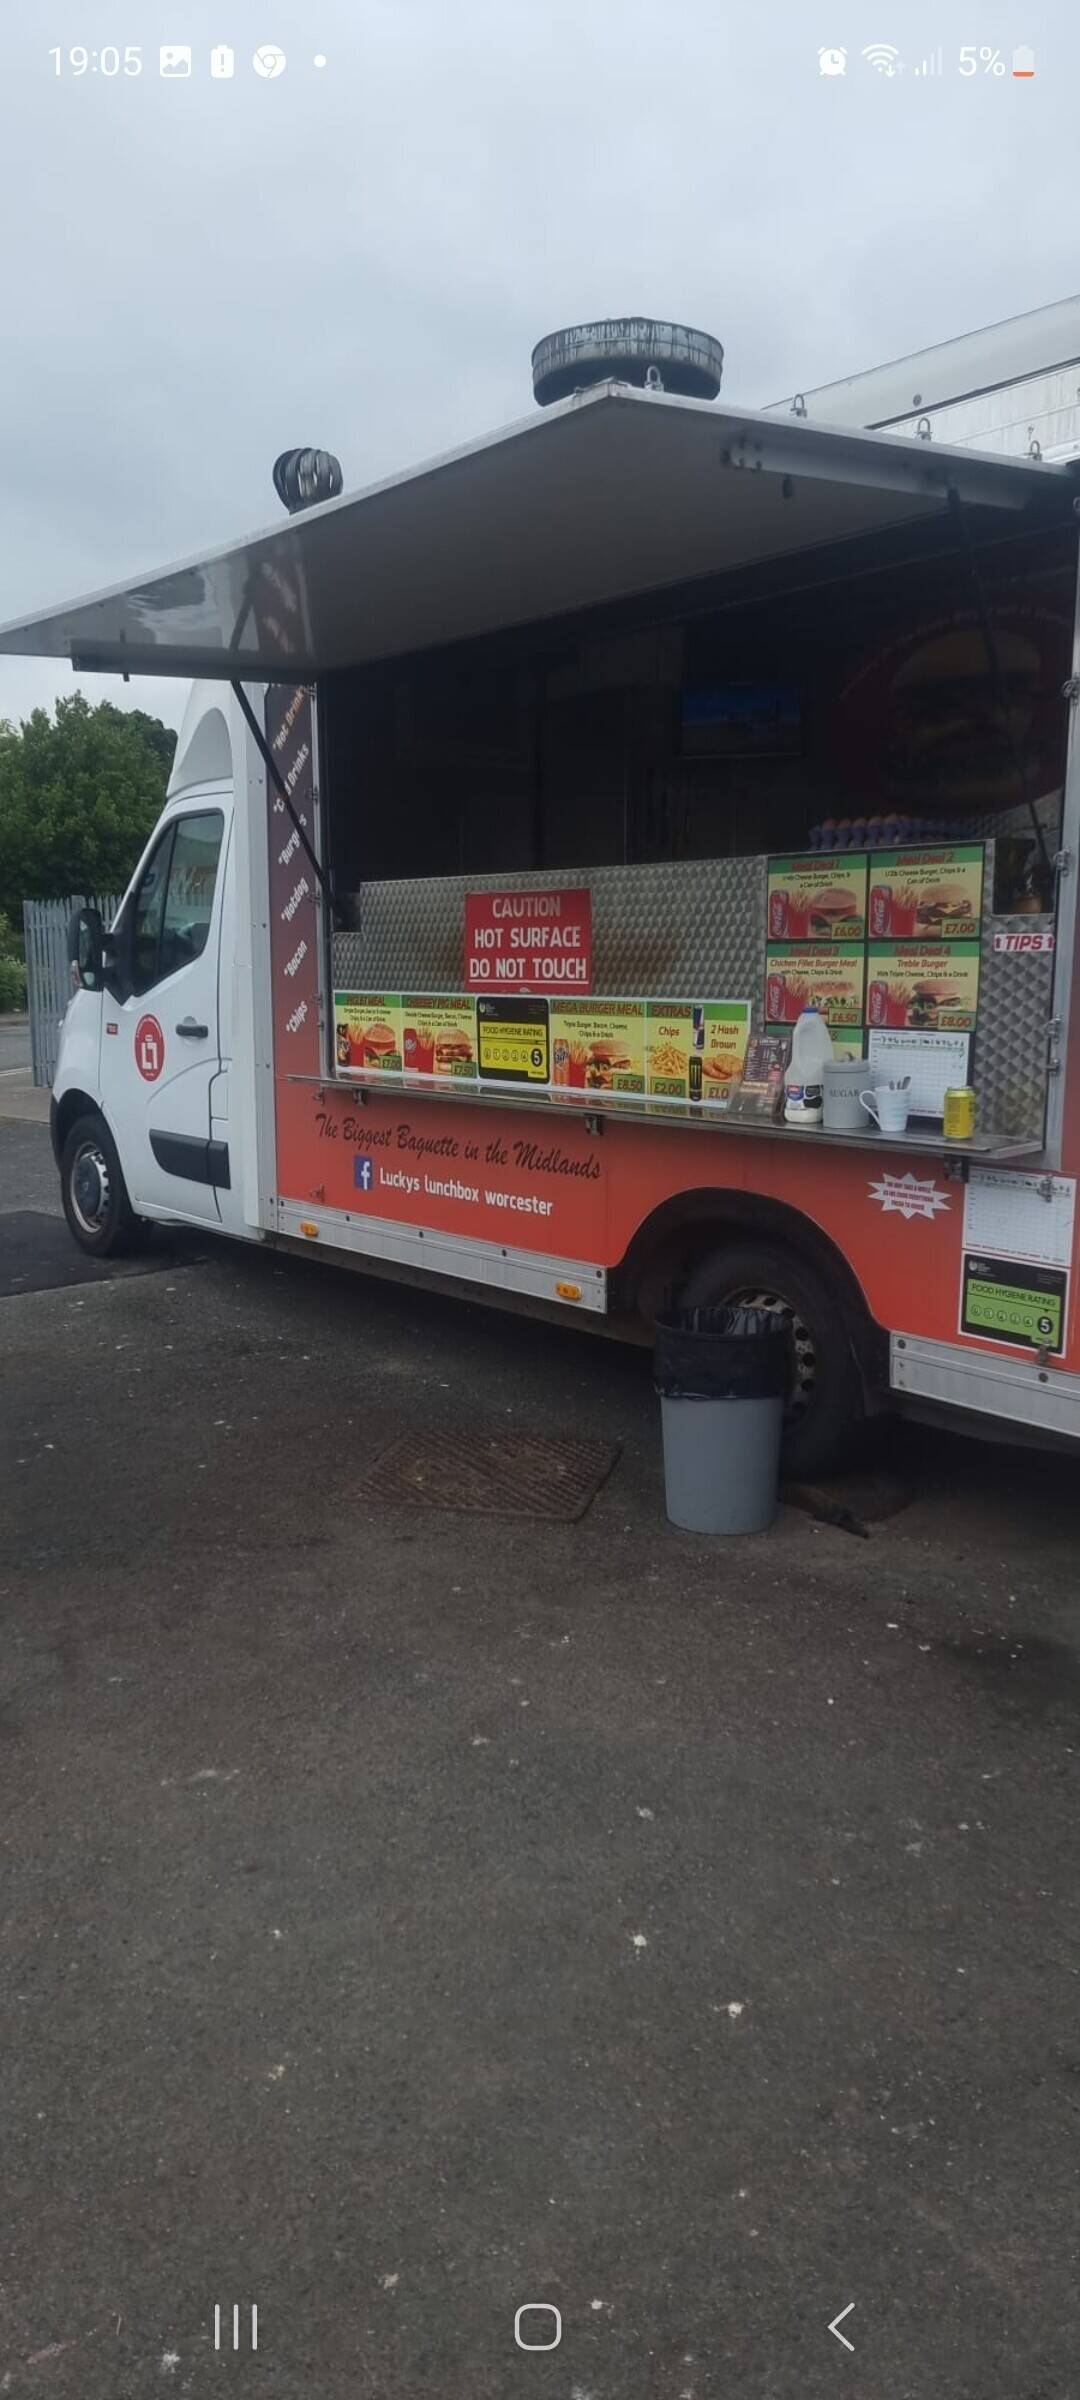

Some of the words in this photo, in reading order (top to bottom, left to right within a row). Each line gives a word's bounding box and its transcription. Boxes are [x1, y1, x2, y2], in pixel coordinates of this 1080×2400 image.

[287, 743, 309, 788] Drinks
[282, 877, 309, 923] Hotdog
[492, 896, 561, 918] CAUTION
[474, 928, 504, 949] HOT
[510, 926, 581, 948] SURFACE
[943, 923, 976, 936] £7.00
[1005, 935, 1043, 950] TIPS
[286, 940, 308, 977] Bacon
[770, 959, 796, 968] Chicken
[816, 959, 838, 969] Burger
[839, 959, 857, 968] Meal
[898, 959, 919, 968] Treble
[921, 959, 948, 969] Burger
[469, 958, 490, 978] DO
[495, 957, 526, 979] NOT
[532, 957, 587, 979] TOUCH
[288, 1001, 308, 1033] Chips
[616, 1003, 643, 1017] MEAL
[652, 1004, 691, 1018] EXTRAS
[483, 1026, 498, 1034] FOOD
[500, 1027, 521, 1036] HYGIENE
[523, 1028, 543, 1037] RATING
[658, 1026, 680, 1037] Chips
[718, 1025, 739, 1036] Hash
[654, 1082, 682, 1095] £2.00
[315, 1113, 337, 1139] The
[342, 1117, 392, 1150] Biggest
[397, 1125, 459, 1160] Baguette
[464, 1144, 479, 1160] in
[485, 1138, 507, 1166] the
[514, 1140, 601, 1180] Midlands
[380, 1167, 420, 1194] Luckys
[424, 1175, 479, 1203] lunchbox
[485, 1190, 553, 1216] worcester
[972, 1283, 994, 1294] FOOD
[995, 1287, 1026, 1300] HYGIENE
[1028, 1294, 1056, 1306] RATING
